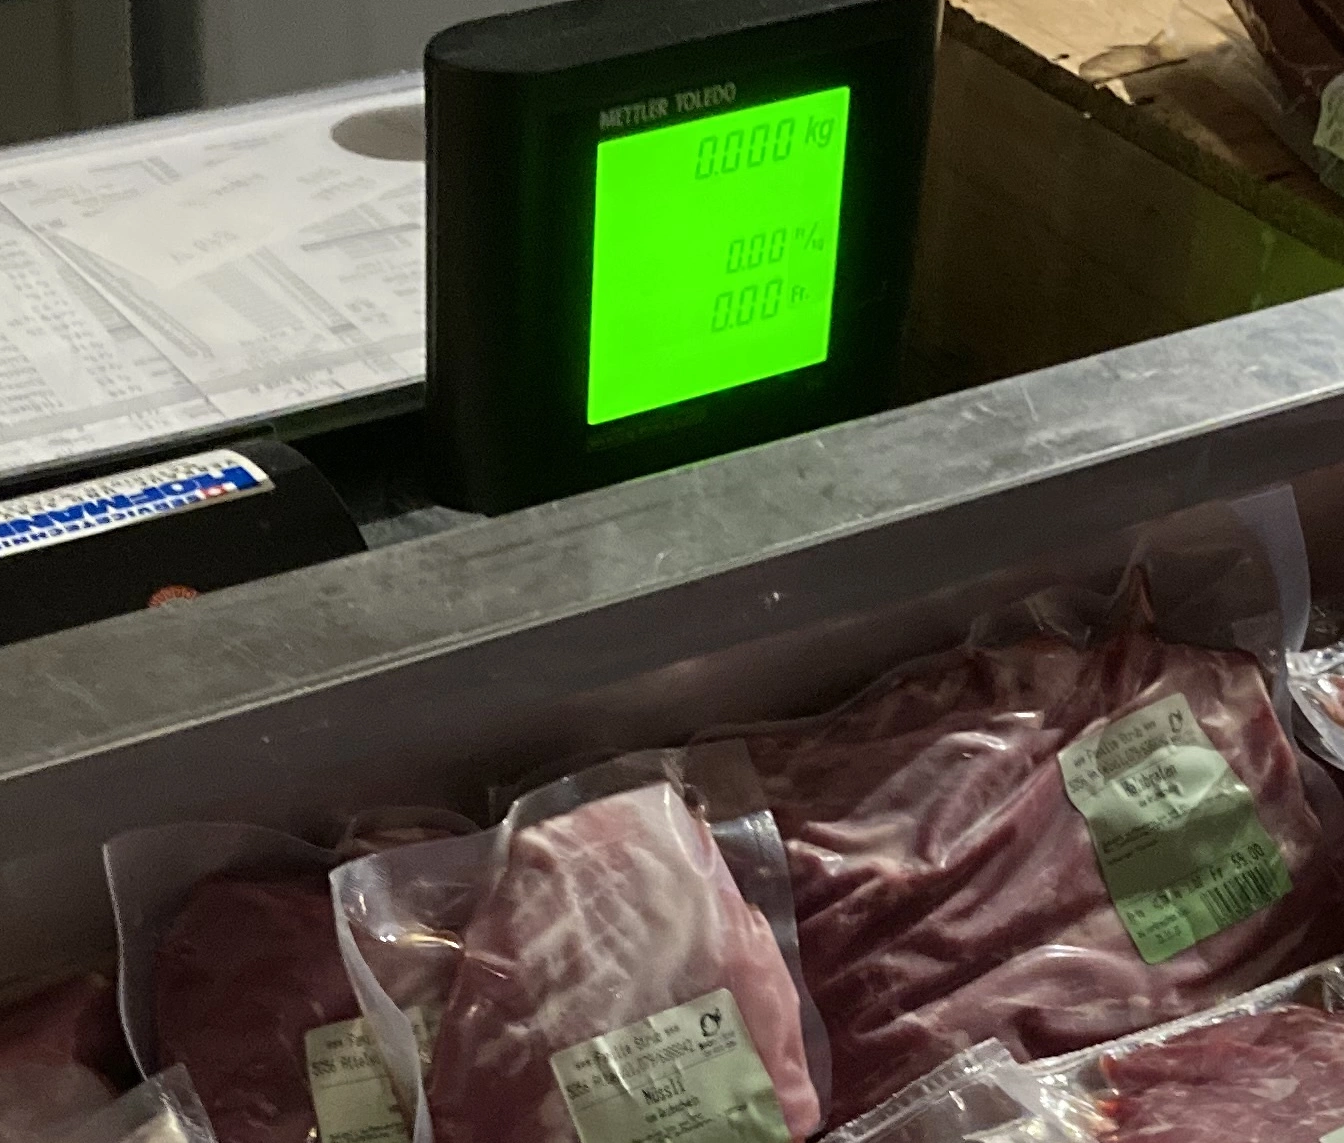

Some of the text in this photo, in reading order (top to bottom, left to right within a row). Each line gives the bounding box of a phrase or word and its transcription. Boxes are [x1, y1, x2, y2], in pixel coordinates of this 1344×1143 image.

[599, 81, 737, 130] METTLER TOLEDO
[694, 115, 834, 181] 0.000 kg
[726, 227, 787, 274] 0.00
[710, 278, 783, 333] 0.00
